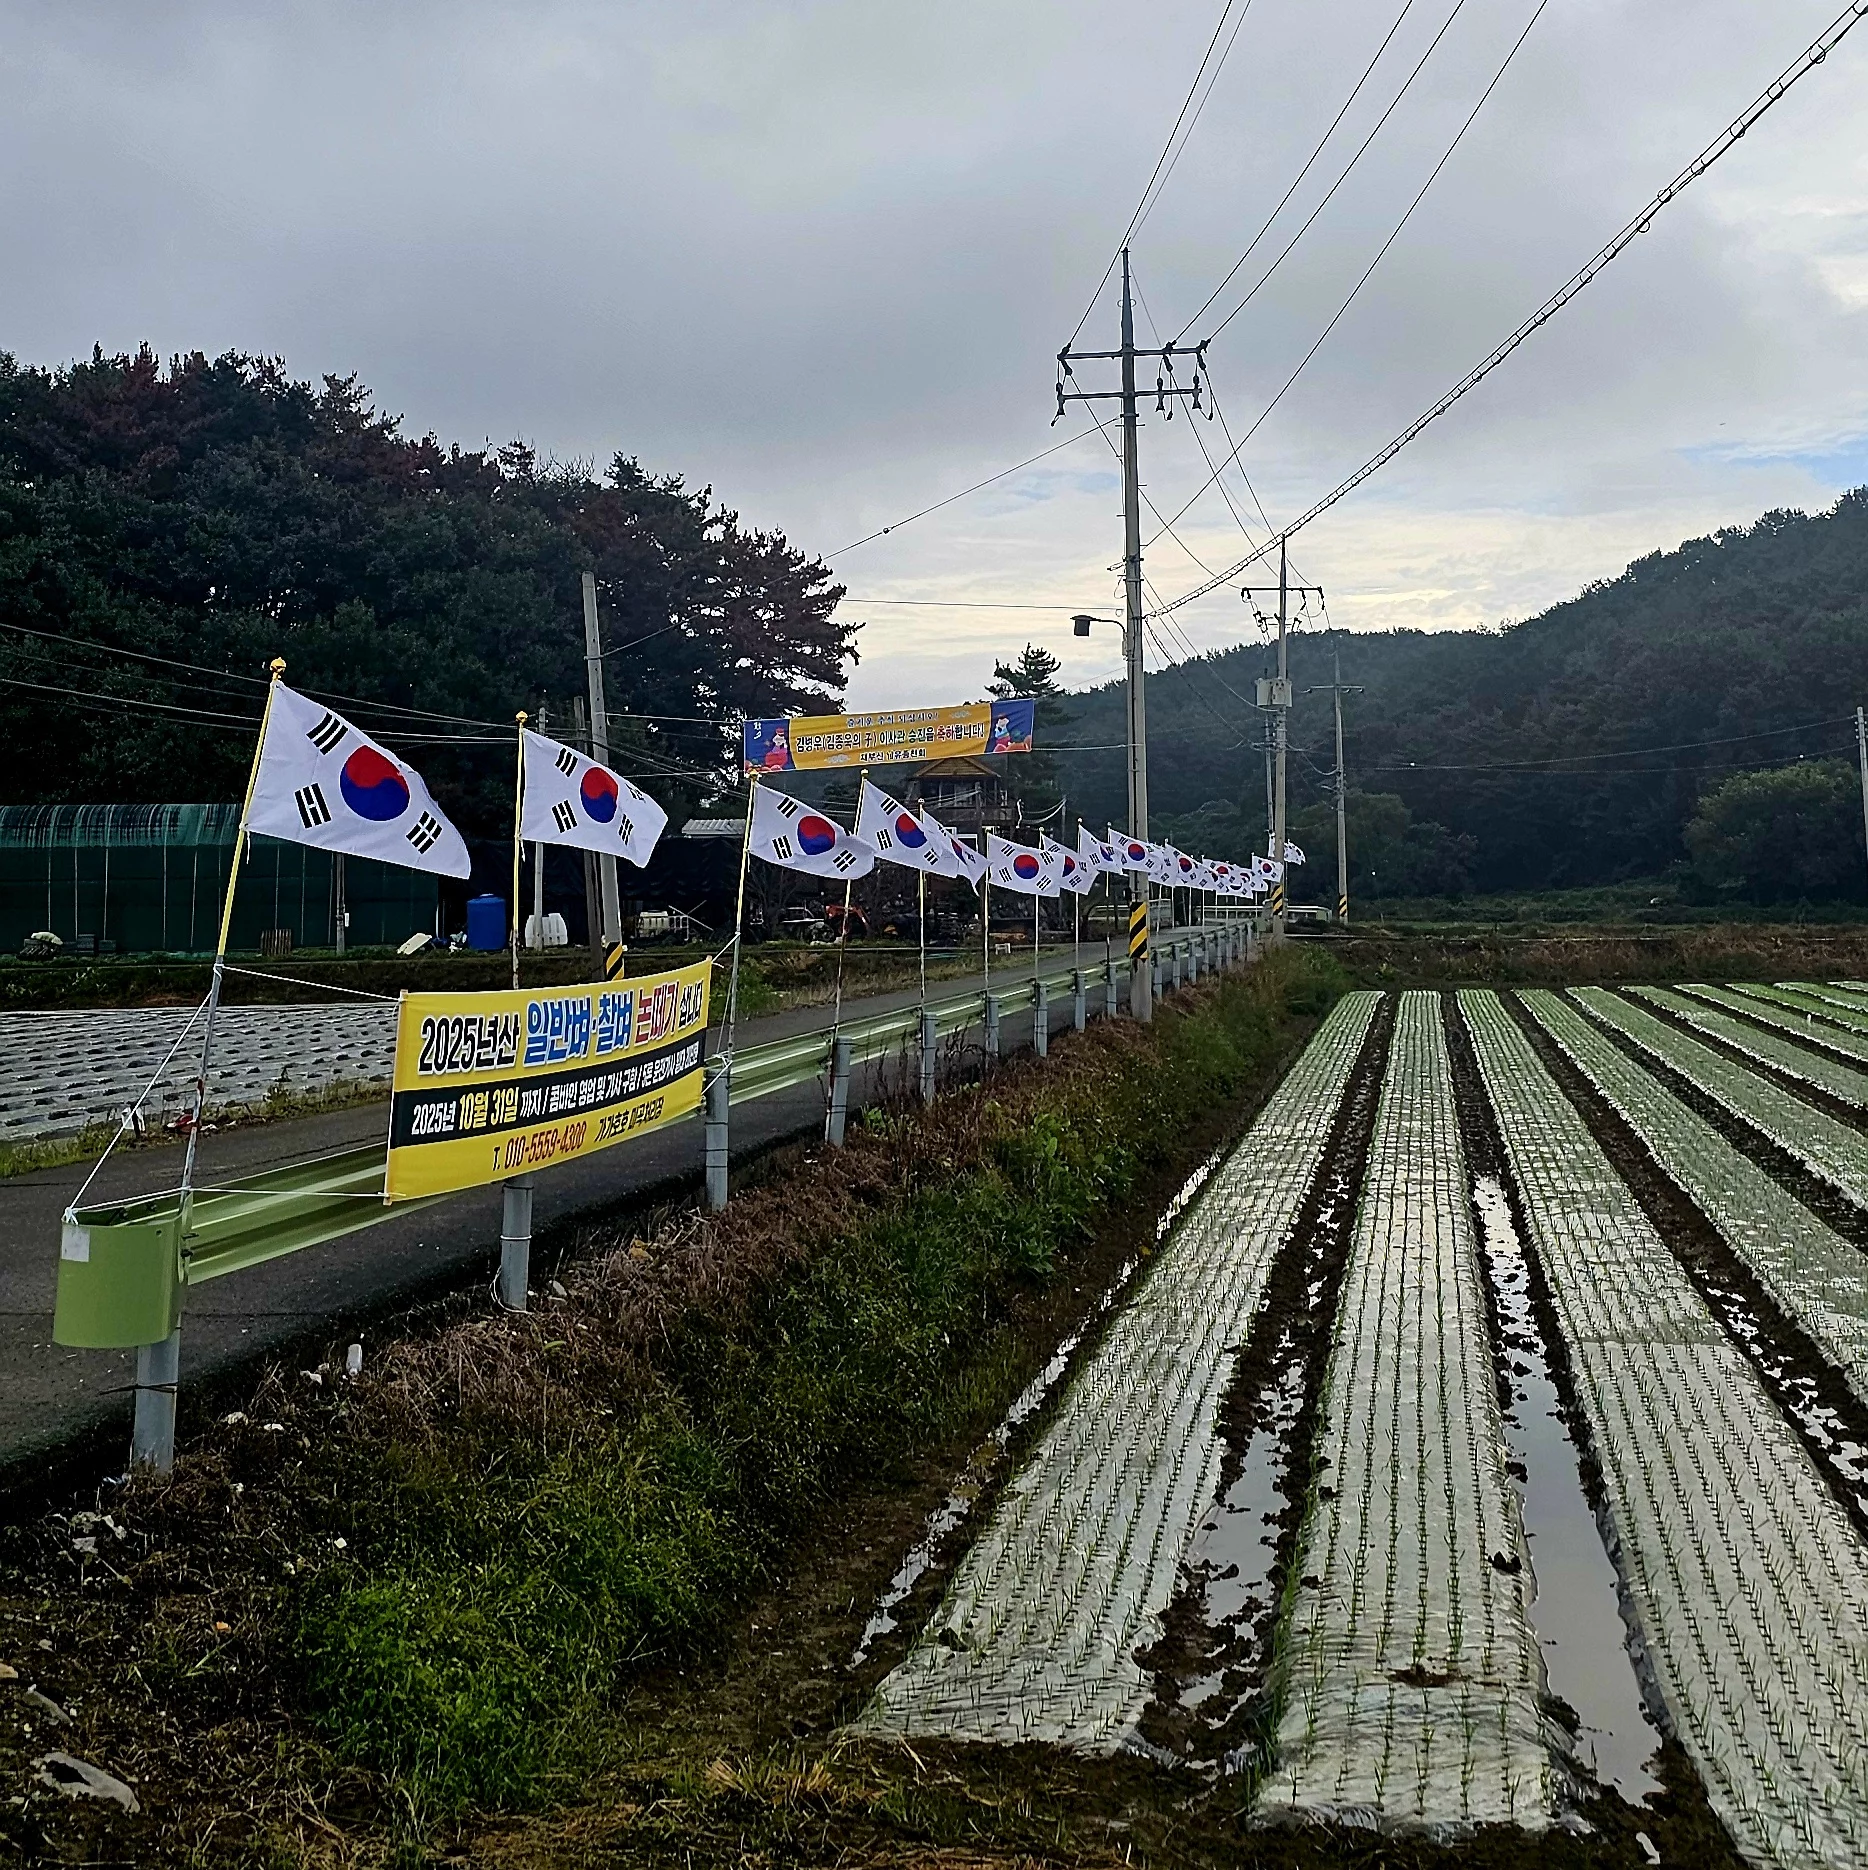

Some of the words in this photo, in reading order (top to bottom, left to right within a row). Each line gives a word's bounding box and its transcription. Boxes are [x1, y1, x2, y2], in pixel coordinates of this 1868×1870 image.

[879, 729, 905, 746] 이사관
[908, 727, 935, 744] 승진을
[937, 723, 984, 741] 축하합니다!
[418, 1013, 520, 1075] 2025년산
[634, 979, 680, 1047] 논떼기
[678, 979, 704, 1031] 삽니다
[411, 1100, 456, 1136] 2025년
[459, 1091, 489, 1131] 10월
[490, 1086, 520, 1126] 31일
[519, 1087, 542, 1118] 까지
[548, 1080, 578, 1113] 콤바인
[578, 1077, 597, 1107] 영업
[595, 1075, 607, 1102] 및
[605, 1070, 623, 1098] 기사
[622, 1066, 638, 1094] 구함
[492, 1146, 501, 1171] T.
[504, 1120, 587, 1170] 010-5559-4300
